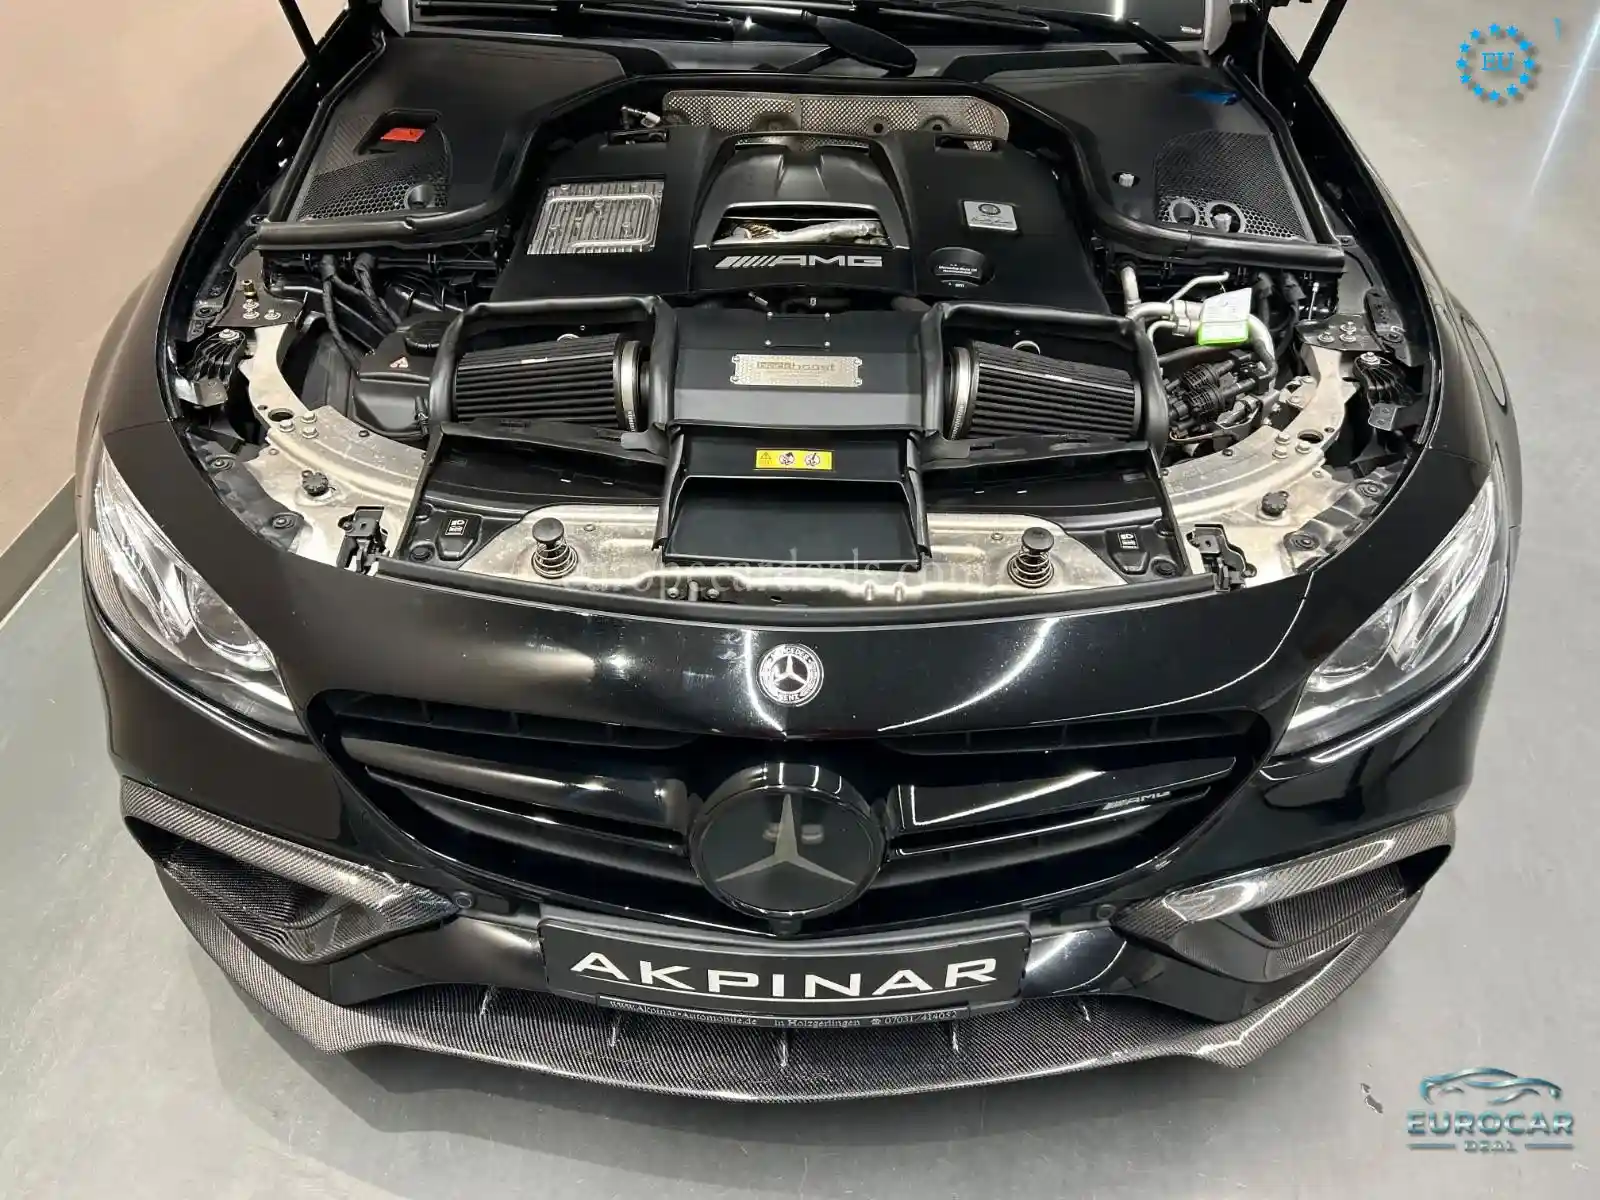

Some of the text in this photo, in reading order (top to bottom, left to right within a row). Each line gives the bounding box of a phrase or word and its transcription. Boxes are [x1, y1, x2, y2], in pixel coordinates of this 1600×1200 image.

[769, 254, 883, 268] AMG
[570, 951, 997, 998] AKPINAR
[787, 1019, 861, 1029] Holzgerlingen
